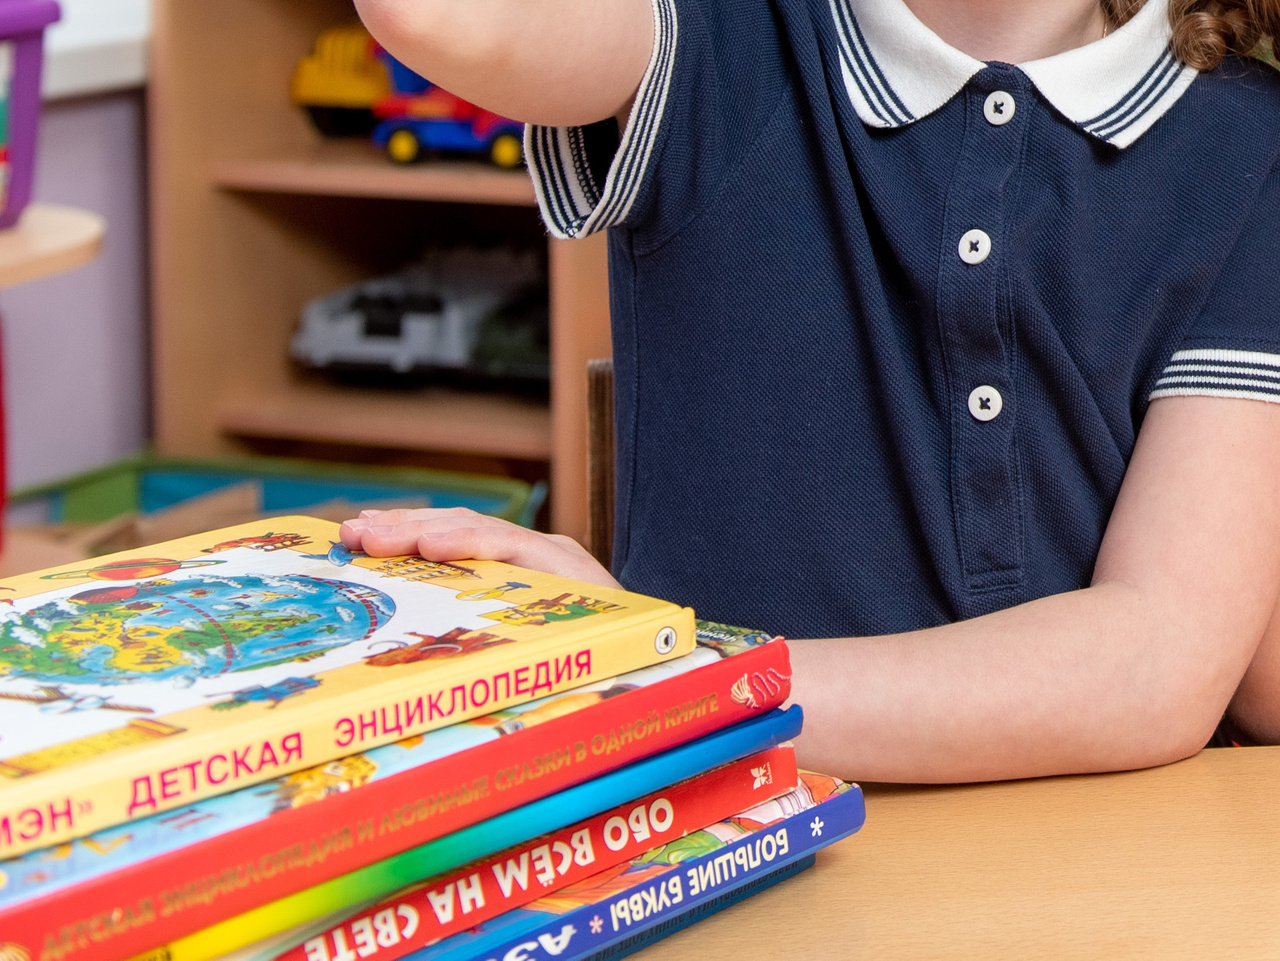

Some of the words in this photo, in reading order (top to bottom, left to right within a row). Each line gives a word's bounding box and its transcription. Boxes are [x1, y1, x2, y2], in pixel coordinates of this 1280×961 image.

[127, 731, 303, 817] ДЕТСКАЯ
[334, 648, 592, 749] ЭНЦИКЛОПЕДИЯ
[40, 898, 155, 960] ДЕТСКАЯ
[158, 825, 354, 917] ЭНЦИКЛОПЕДИЯ
[356, 821, 375, 844] И
[378, 772, 490, 837] ЛЮБИМЫЕ
[493, 746, 571, 795] СКАЗКИ
[574, 742, 590, 765] В
[591, 710, 661, 758] ОДНОЙ
[664, 692, 719, 730] КНИГЕ
[603, 797, 675, 852] ОБО
[492, 827, 595, 899] ВСЁМ
[689, 827, 790, 897] БОЛЬШИЕ
[426, 873, 486, 925] НА
[611, 876, 684, 932] БУКВЫ
[304, 903, 419, 961] СВЕТЕ
